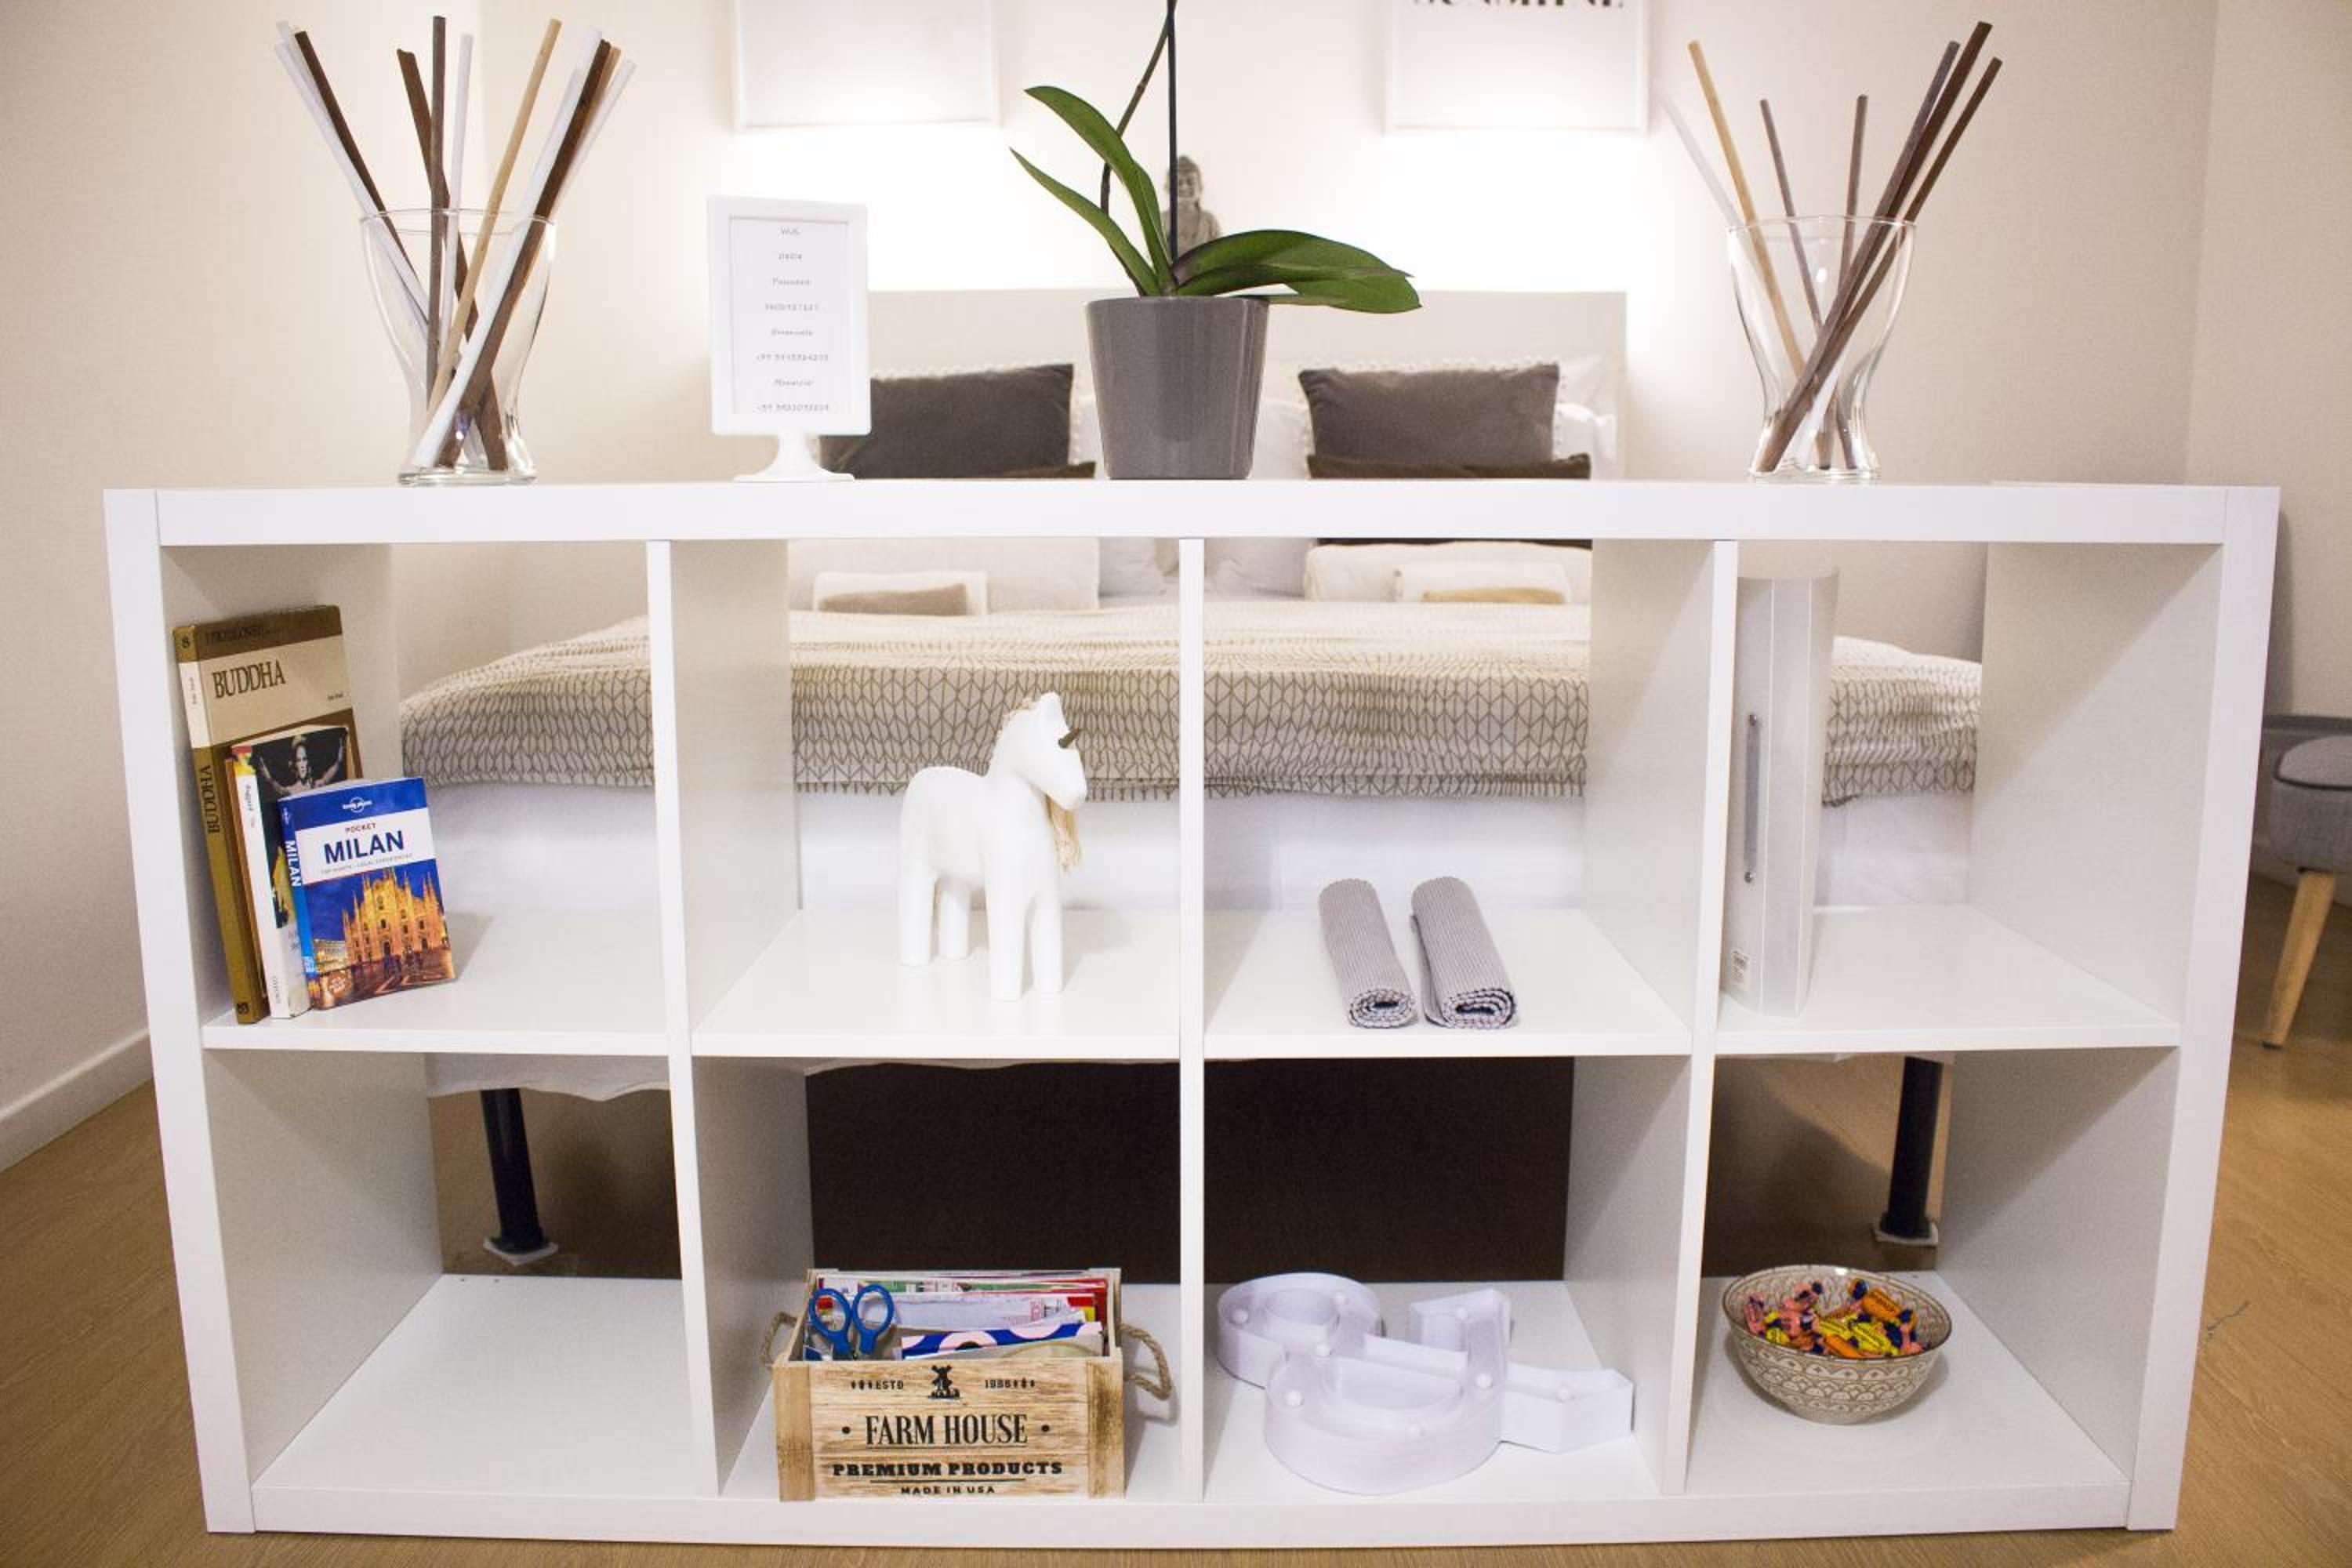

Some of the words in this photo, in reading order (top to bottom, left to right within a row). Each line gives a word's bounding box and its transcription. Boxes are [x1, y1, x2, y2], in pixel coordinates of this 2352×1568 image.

[212, 659, 286, 699] BUDDHA
[200, 764, 220, 833] BUDDHA
[285, 840, 302, 887] MILAN
[324, 830, 404, 865] MILAN
[865, 1414, 935, 1445] FARM
[944, 1413, 1028, 1444] HOUSE
[833, 1463, 941, 1476] PREMIUM
[948, 1461, 1062, 1475] PRODUCTS
[901, 1486, 940, 1495] MADE
